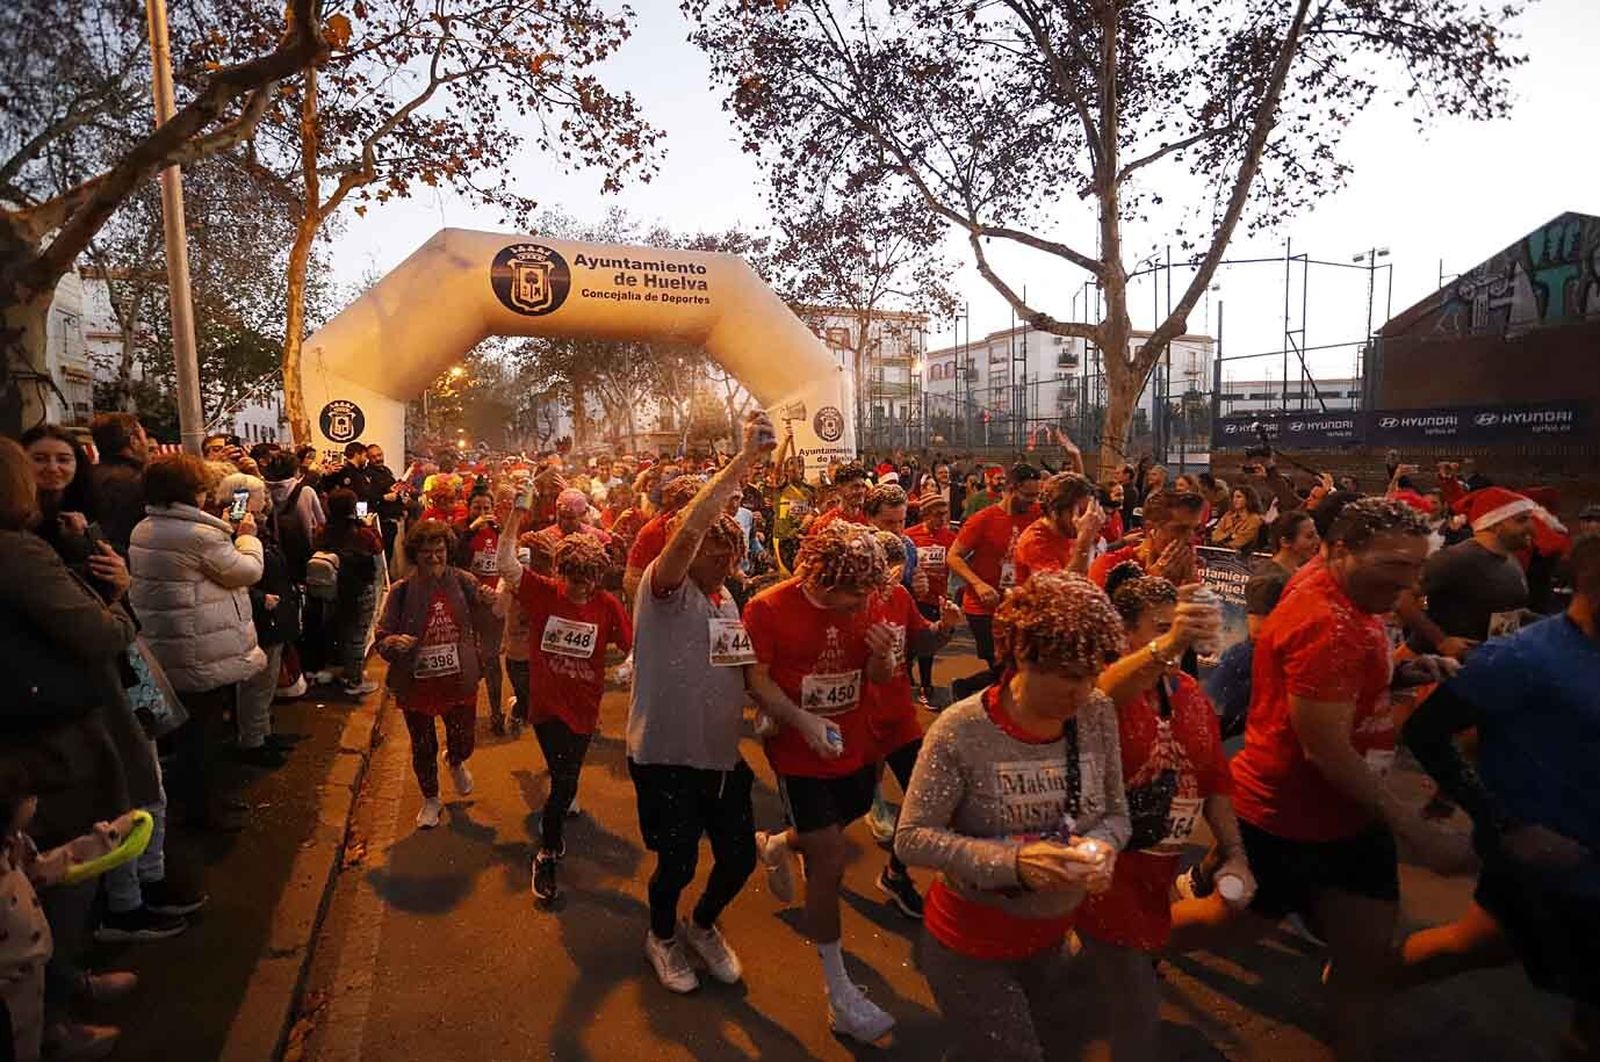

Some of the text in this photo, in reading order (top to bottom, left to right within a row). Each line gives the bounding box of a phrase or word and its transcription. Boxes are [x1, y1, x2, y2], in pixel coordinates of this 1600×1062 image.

[574, 254, 707, 275] Ayuntamiento
[614, 272, 708, 291] de Huelva
[644, 292, 658, 302] de
[661, 293, 710, 305] Deportes
[1307, 420, 1353, 430] HYUNDAI
[1401, 416, 1458, 428] HYUNDAI
[1502, 411, 1573, 425] HYUNDAI
[565, 630, 591, 649] 448
[430, 653, 454, 668] 398
[827, 684, 855, 703] 450
